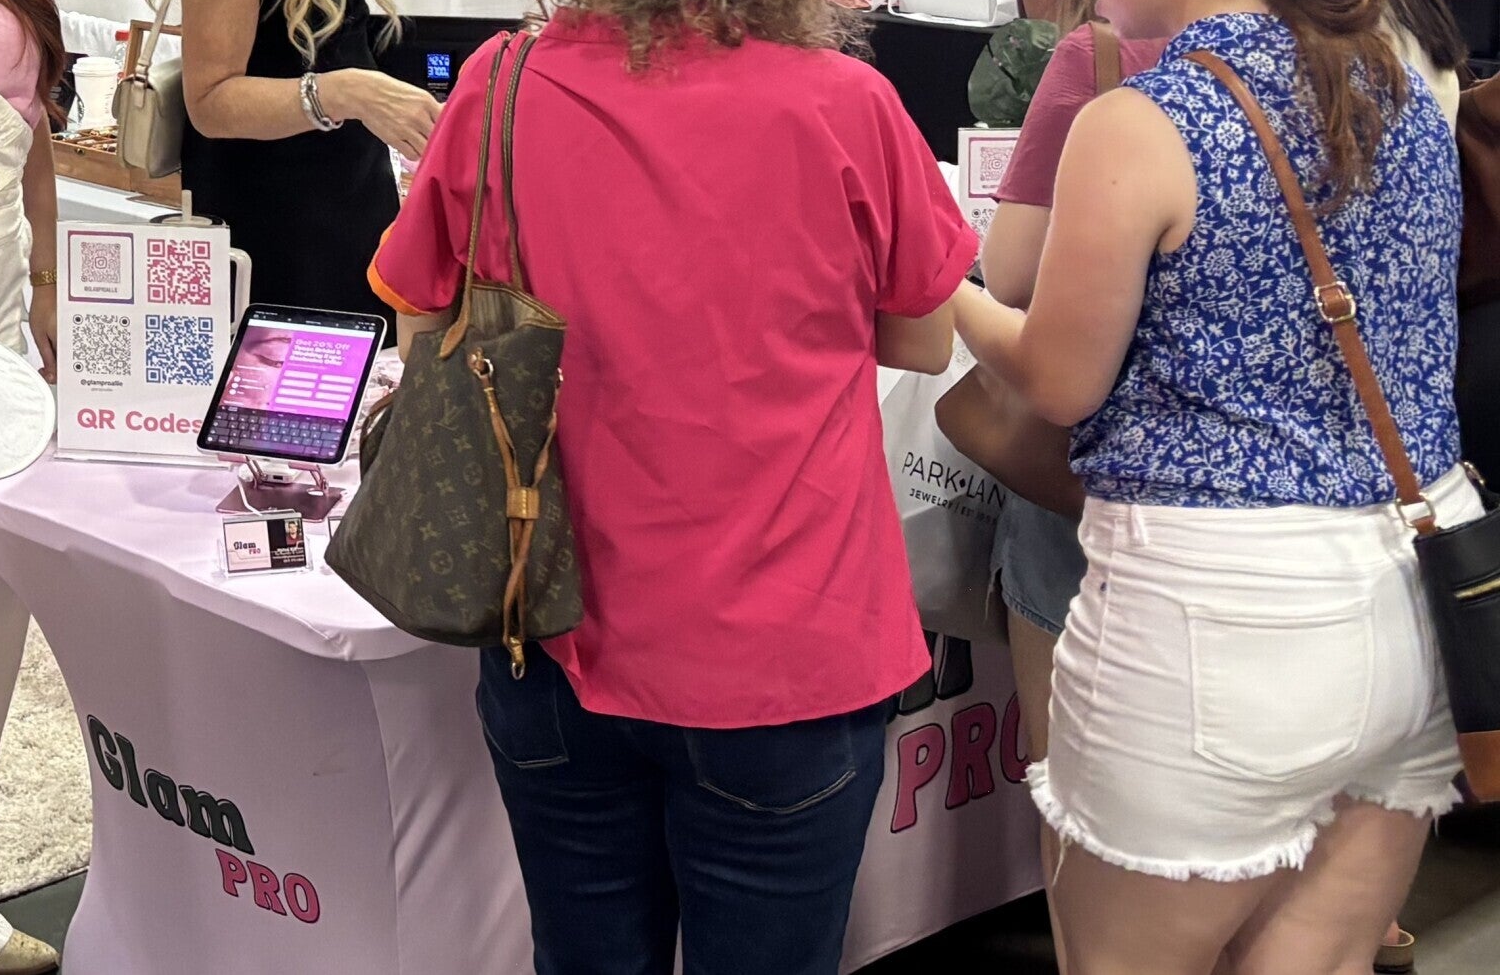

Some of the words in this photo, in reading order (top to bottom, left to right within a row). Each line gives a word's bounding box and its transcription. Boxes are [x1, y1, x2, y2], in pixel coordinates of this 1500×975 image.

[76, 408, 116, 430] QR
[125, 410, 204, 434] Codes
[966, 474, 1006, 508] LAN
[233, 541, 256, 551] Glam
[86, 713, 256, 856] Glam
[214, 848, 321, 924] PRO
